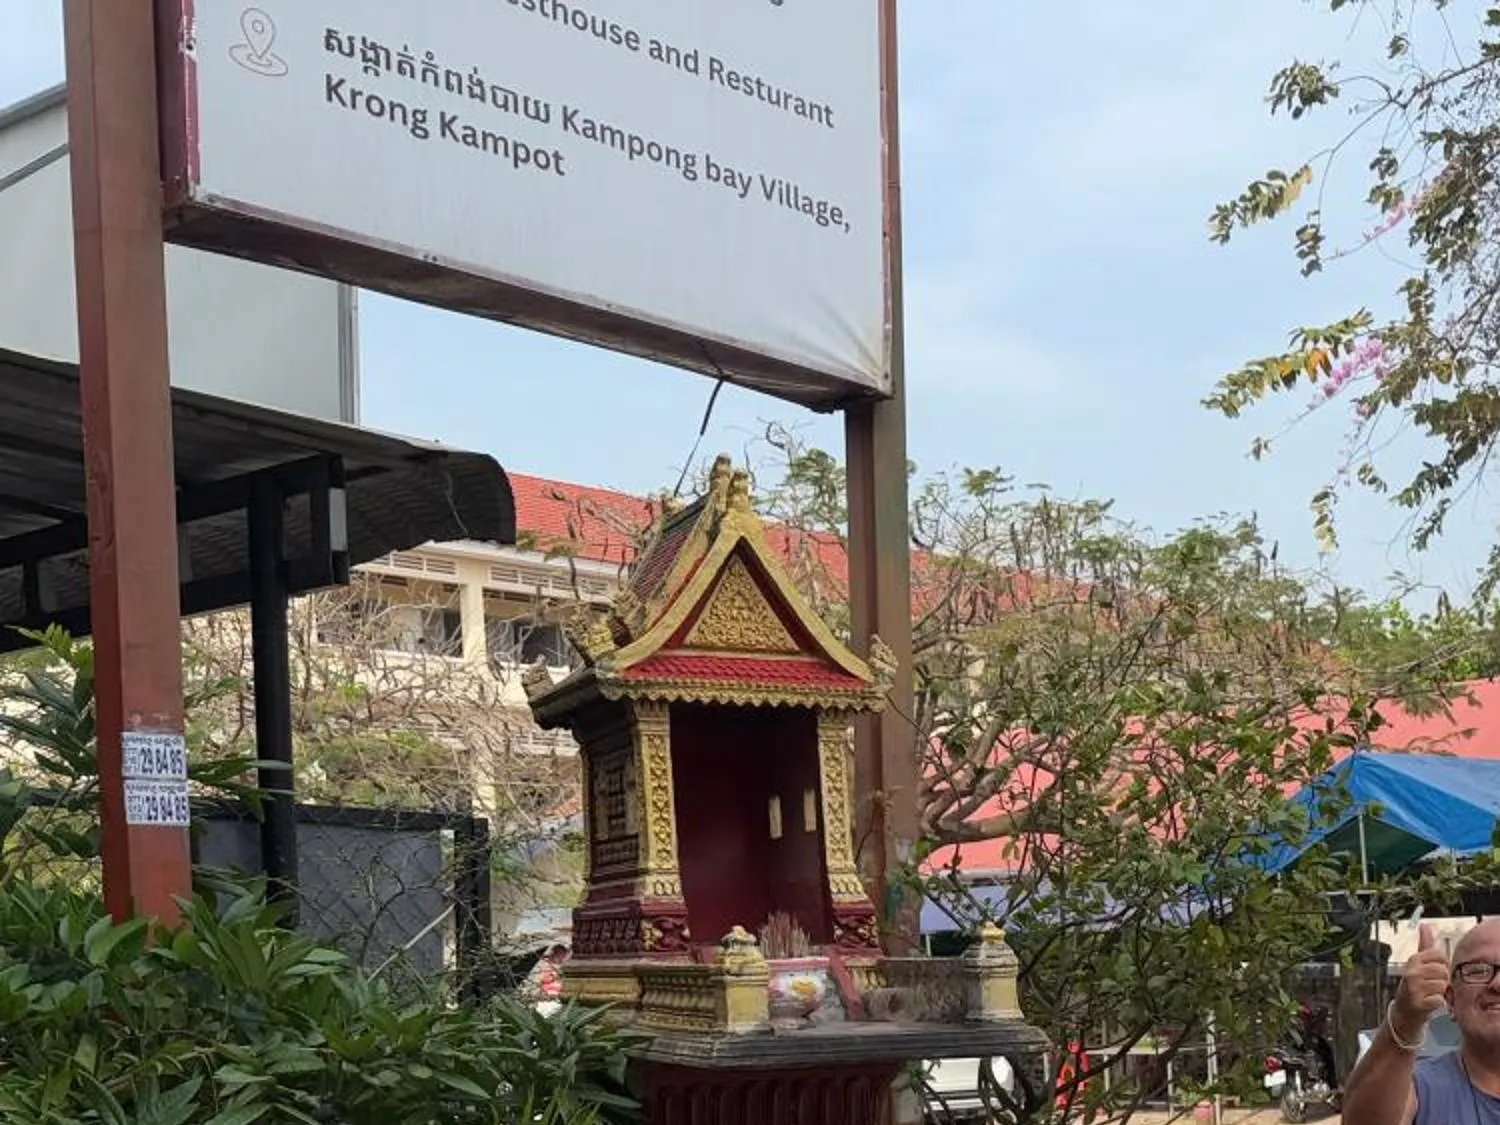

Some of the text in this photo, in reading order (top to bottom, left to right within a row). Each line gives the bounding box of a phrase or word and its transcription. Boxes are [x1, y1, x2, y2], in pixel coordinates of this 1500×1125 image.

[324, 73, 566, 176] Krong Kampot
[506, 0, 835, 128] sthouse and Resturant
[561, 104, 851, 233] Kampong bay Village,
